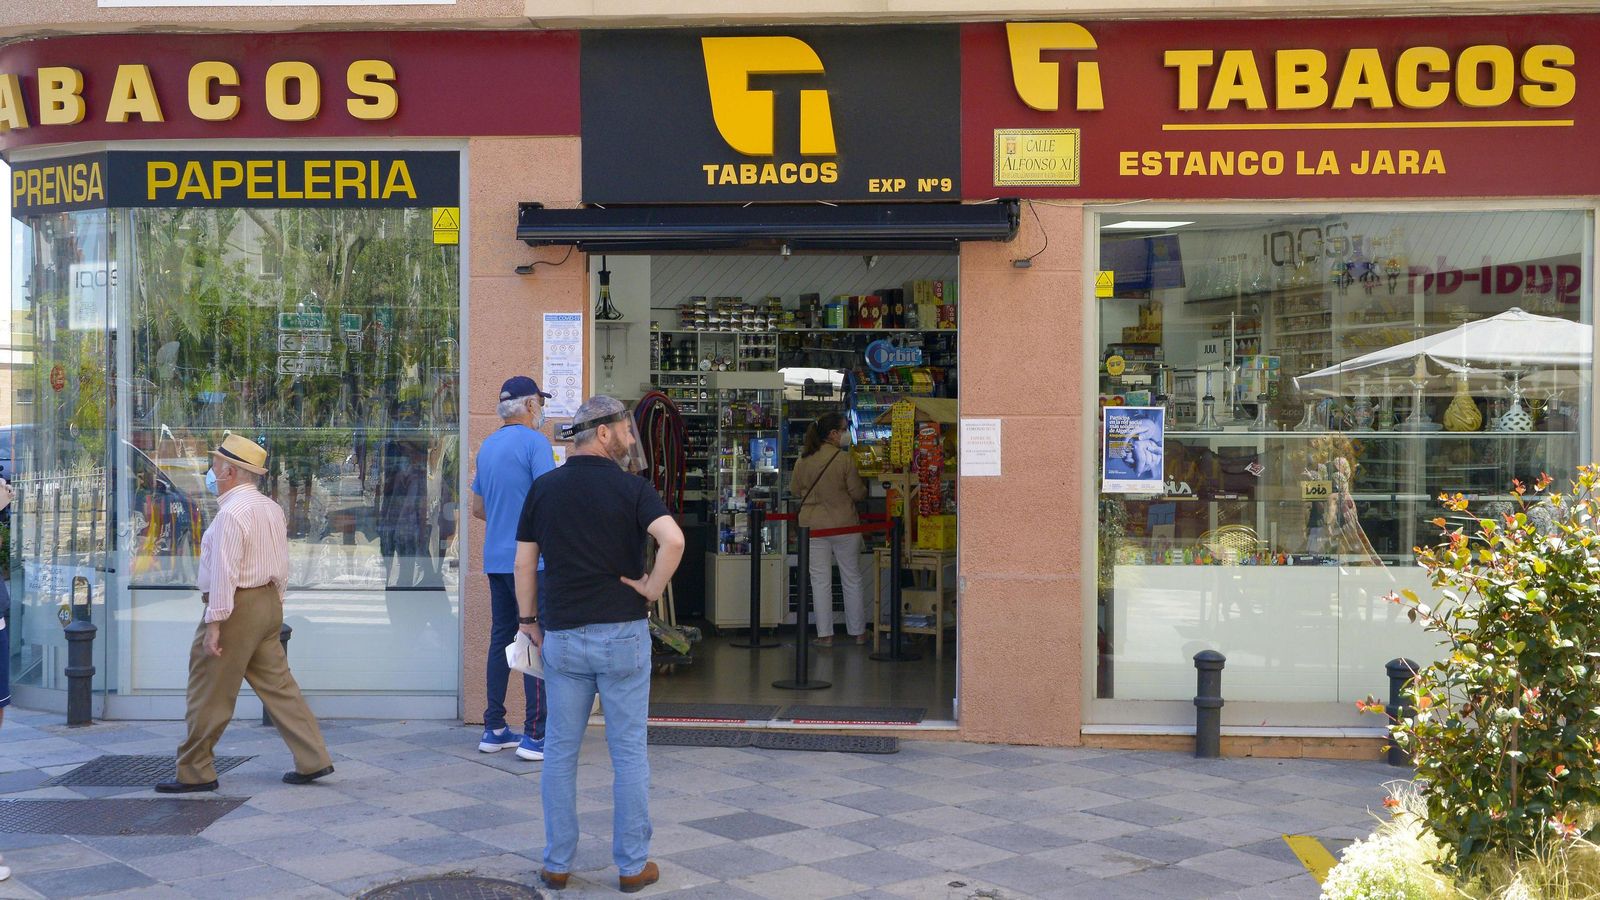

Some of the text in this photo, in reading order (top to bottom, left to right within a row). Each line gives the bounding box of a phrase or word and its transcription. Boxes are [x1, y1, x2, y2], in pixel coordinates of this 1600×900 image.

[1164, 45, 1577, 111] TABACOS
[1026, 139, 1056, 153] CALLE
[1002, 155, 1072, 171] ALFONSO XI
[1119, 149, 1448, 176] ESTANCO LA JARA
[147, 160, 418, 200] PAPELERIA
[702, 162, 838, 185] TABACOS
[12, 161, 104, 208] PRENSA
[868, 179, 907, 193] EXP
[873, 347, 918, 364] Orbit
[59, 609, 71, 621] 49
